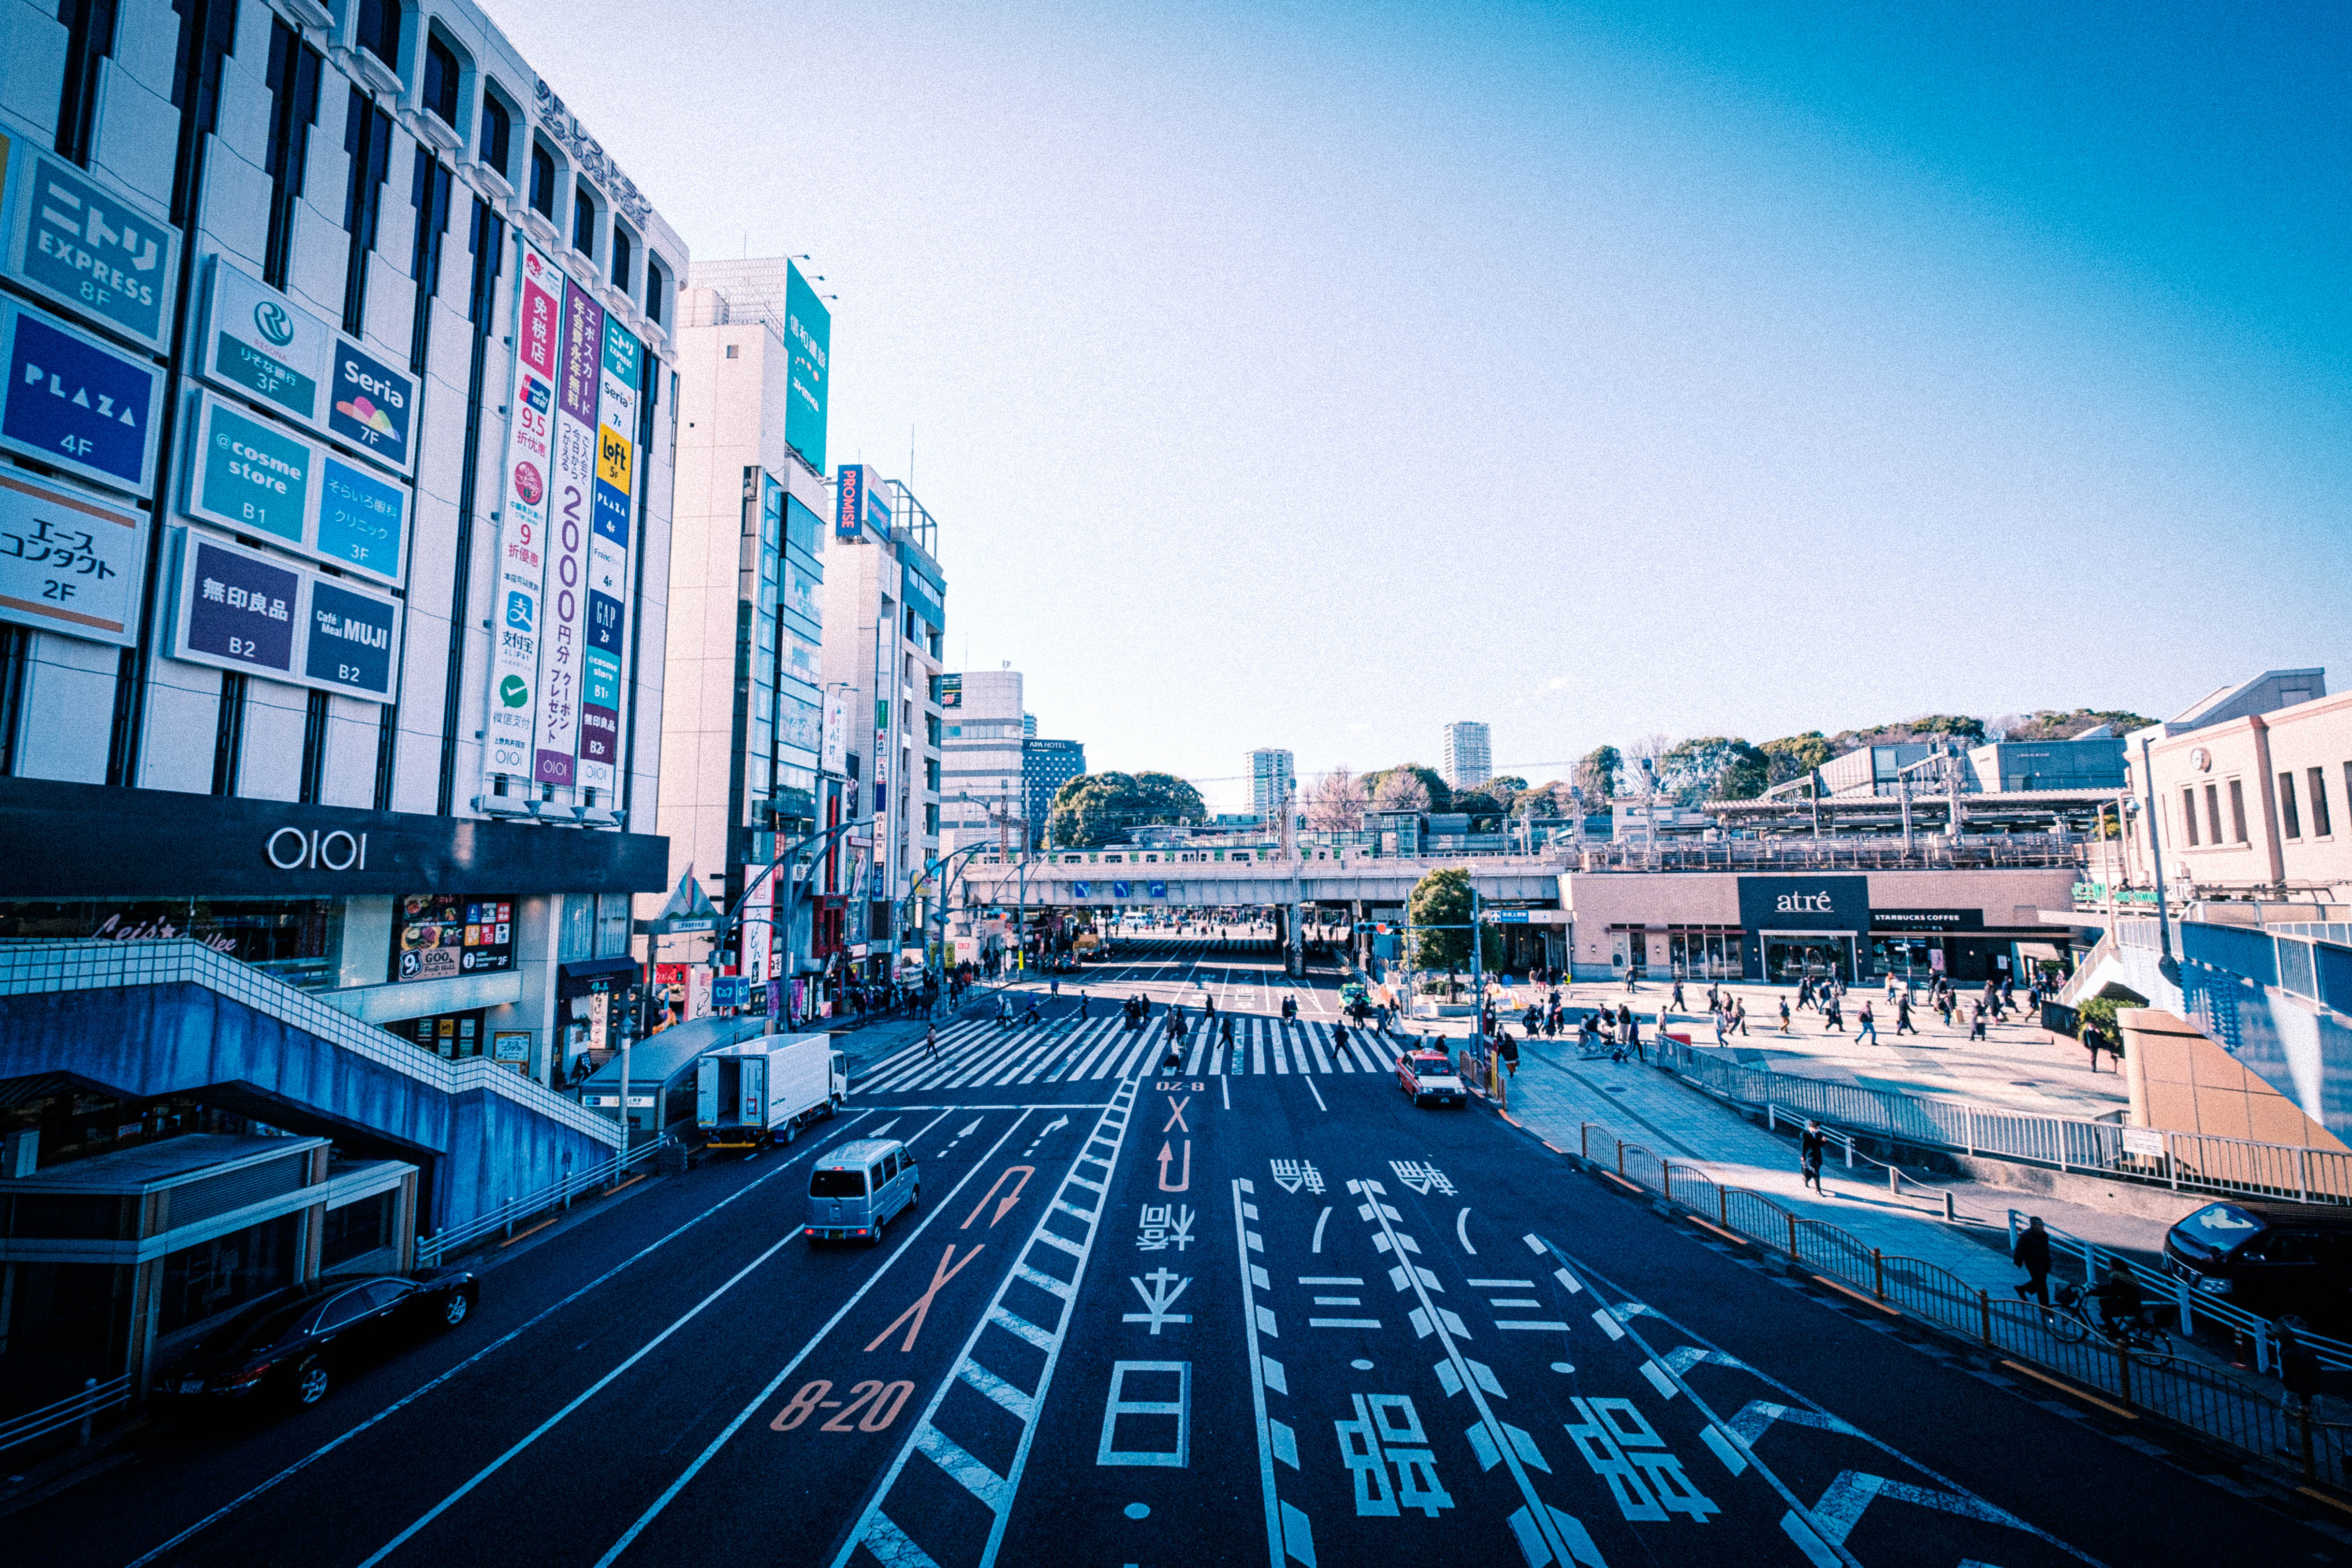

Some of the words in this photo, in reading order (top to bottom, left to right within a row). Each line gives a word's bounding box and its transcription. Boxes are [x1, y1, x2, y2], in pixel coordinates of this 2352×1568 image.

[43, 181, 158, 271] ニトリ
[39, 229, 152, 307] EXPRESS
[80, 281, 111, 307] 8F
[254, 338, 287, 362] RESONA
[610, 327, 633, 355] ニトリ
[240, 348, 296, 386] りそな銀行
[582, 308, 596, 415] エポスカード
[26, 363, 136, 428] PLAZA
[257, 373, 279, 393] 3F
[345, 360, 404, 409] Seria
[605, 382, 628, 408] Seria
[522, 407, 545, 437] 9.5
[614, 414, 621, 427] 7F
[60, 434, 93, 457] 4F
[360, 425, 380, 446] 7F
[217, 433, 302, 481] @cosme
[229, 461, 287, 494] store
[610, 468, 618, 479] 5F
[329, 479, 397, 517] そらいろ眼科
[598, 493, 626, 517] PLAZA
[842, 471, 856, 528] PROMISE
[244, 503, 265, 524] B1
[335, 509, 388, 539] クリニック
[33, 519, 93, 554] エース
[521, 524, 531, 545] 9
[606, 521, 616, 533] 4F
[1, 532, 116, 579] コンタクト
[351, 544, 368, 561] 3F
[43, 580, 75, 601] 2F
[604, 575, 612, 587] 4F
[203, 577, 289, 621] 無印良品
[597, 601, 615, 628] GAP
[321, 623, 342, 637] Meal
[344, 618, 387, 650] MUJI
[502, 631, 533, 654] 支付宝
[600, 630, 609, 643] 2F
[230, 638, 255, 658] B2
[339, 664, 360, 682] B2
[588, 655, 617, 672] @cosme
[594, 668, 613, 681] store
[548, 669, 561, 743] プレゼント
[560, 672, 571, 729] クーポン
[584, 713, 615, 732] 無印良品
[590, 741, 605, 754] B2F
[1777, 891, 1831, 910] atré
[771, 1379, 914, 1432] 8-20
